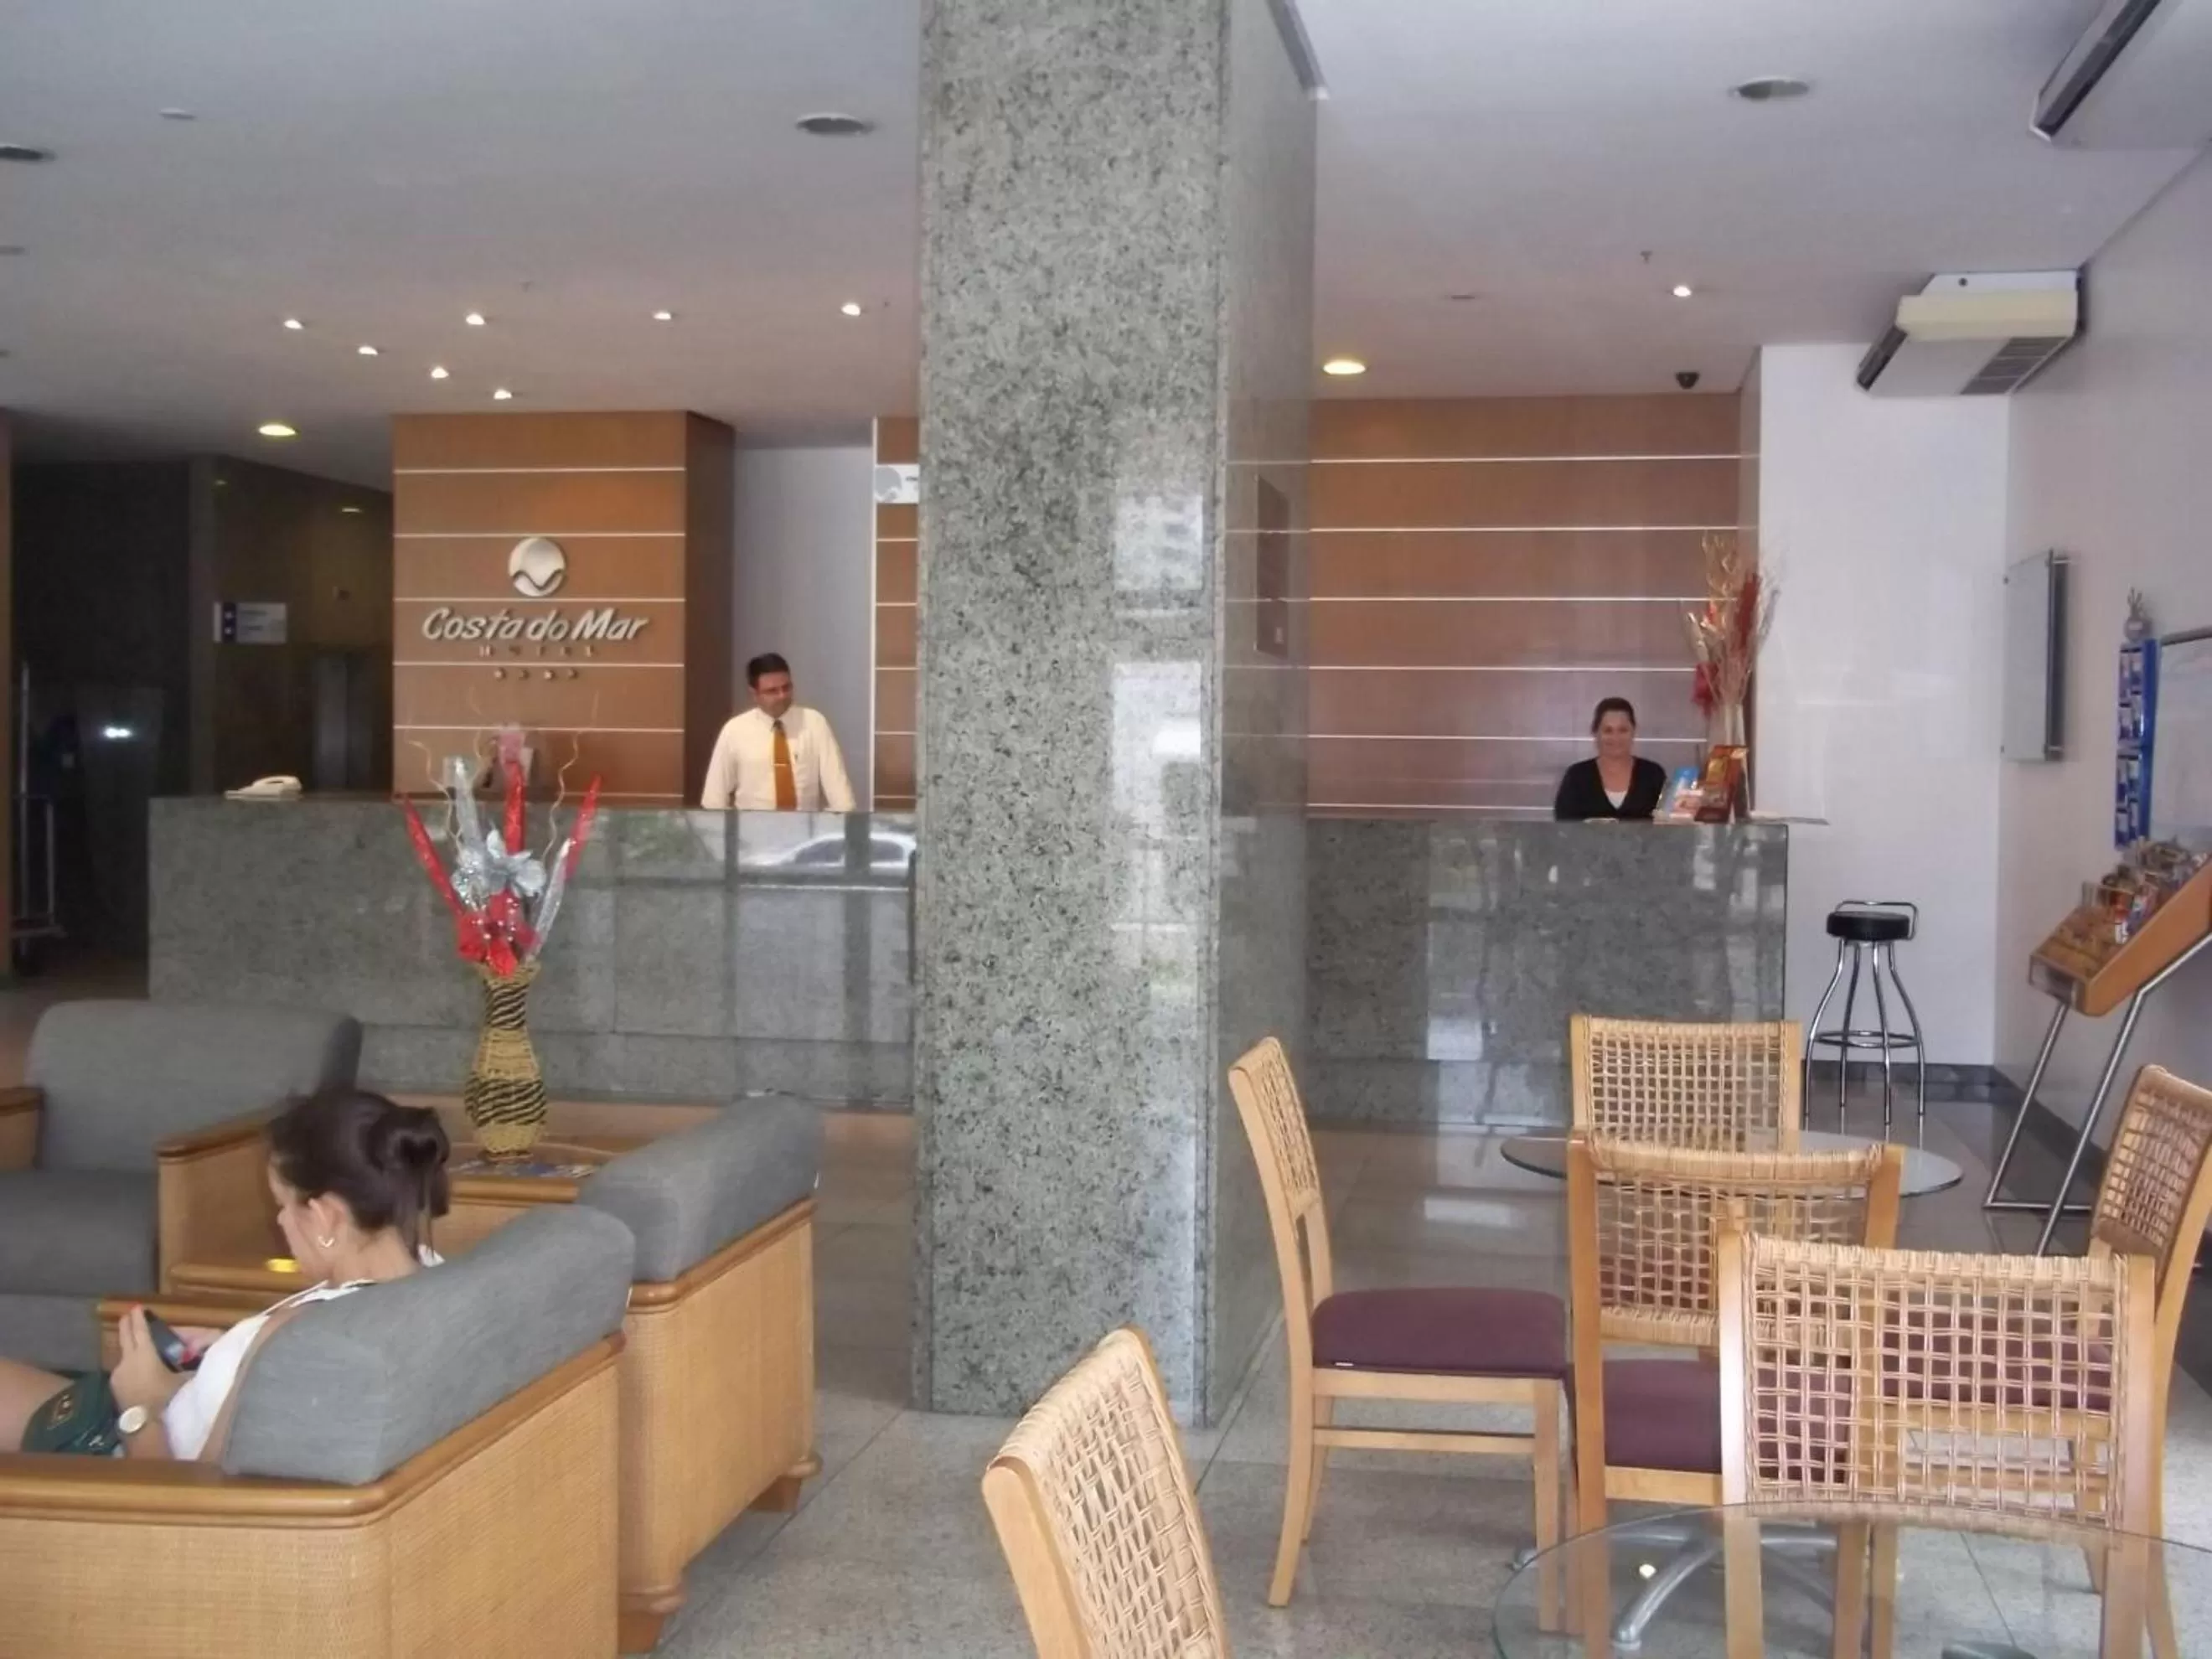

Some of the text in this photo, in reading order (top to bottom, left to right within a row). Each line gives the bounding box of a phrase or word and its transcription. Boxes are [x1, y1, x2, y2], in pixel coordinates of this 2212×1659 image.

[421, 606, 649, 641] Costa do Mar
